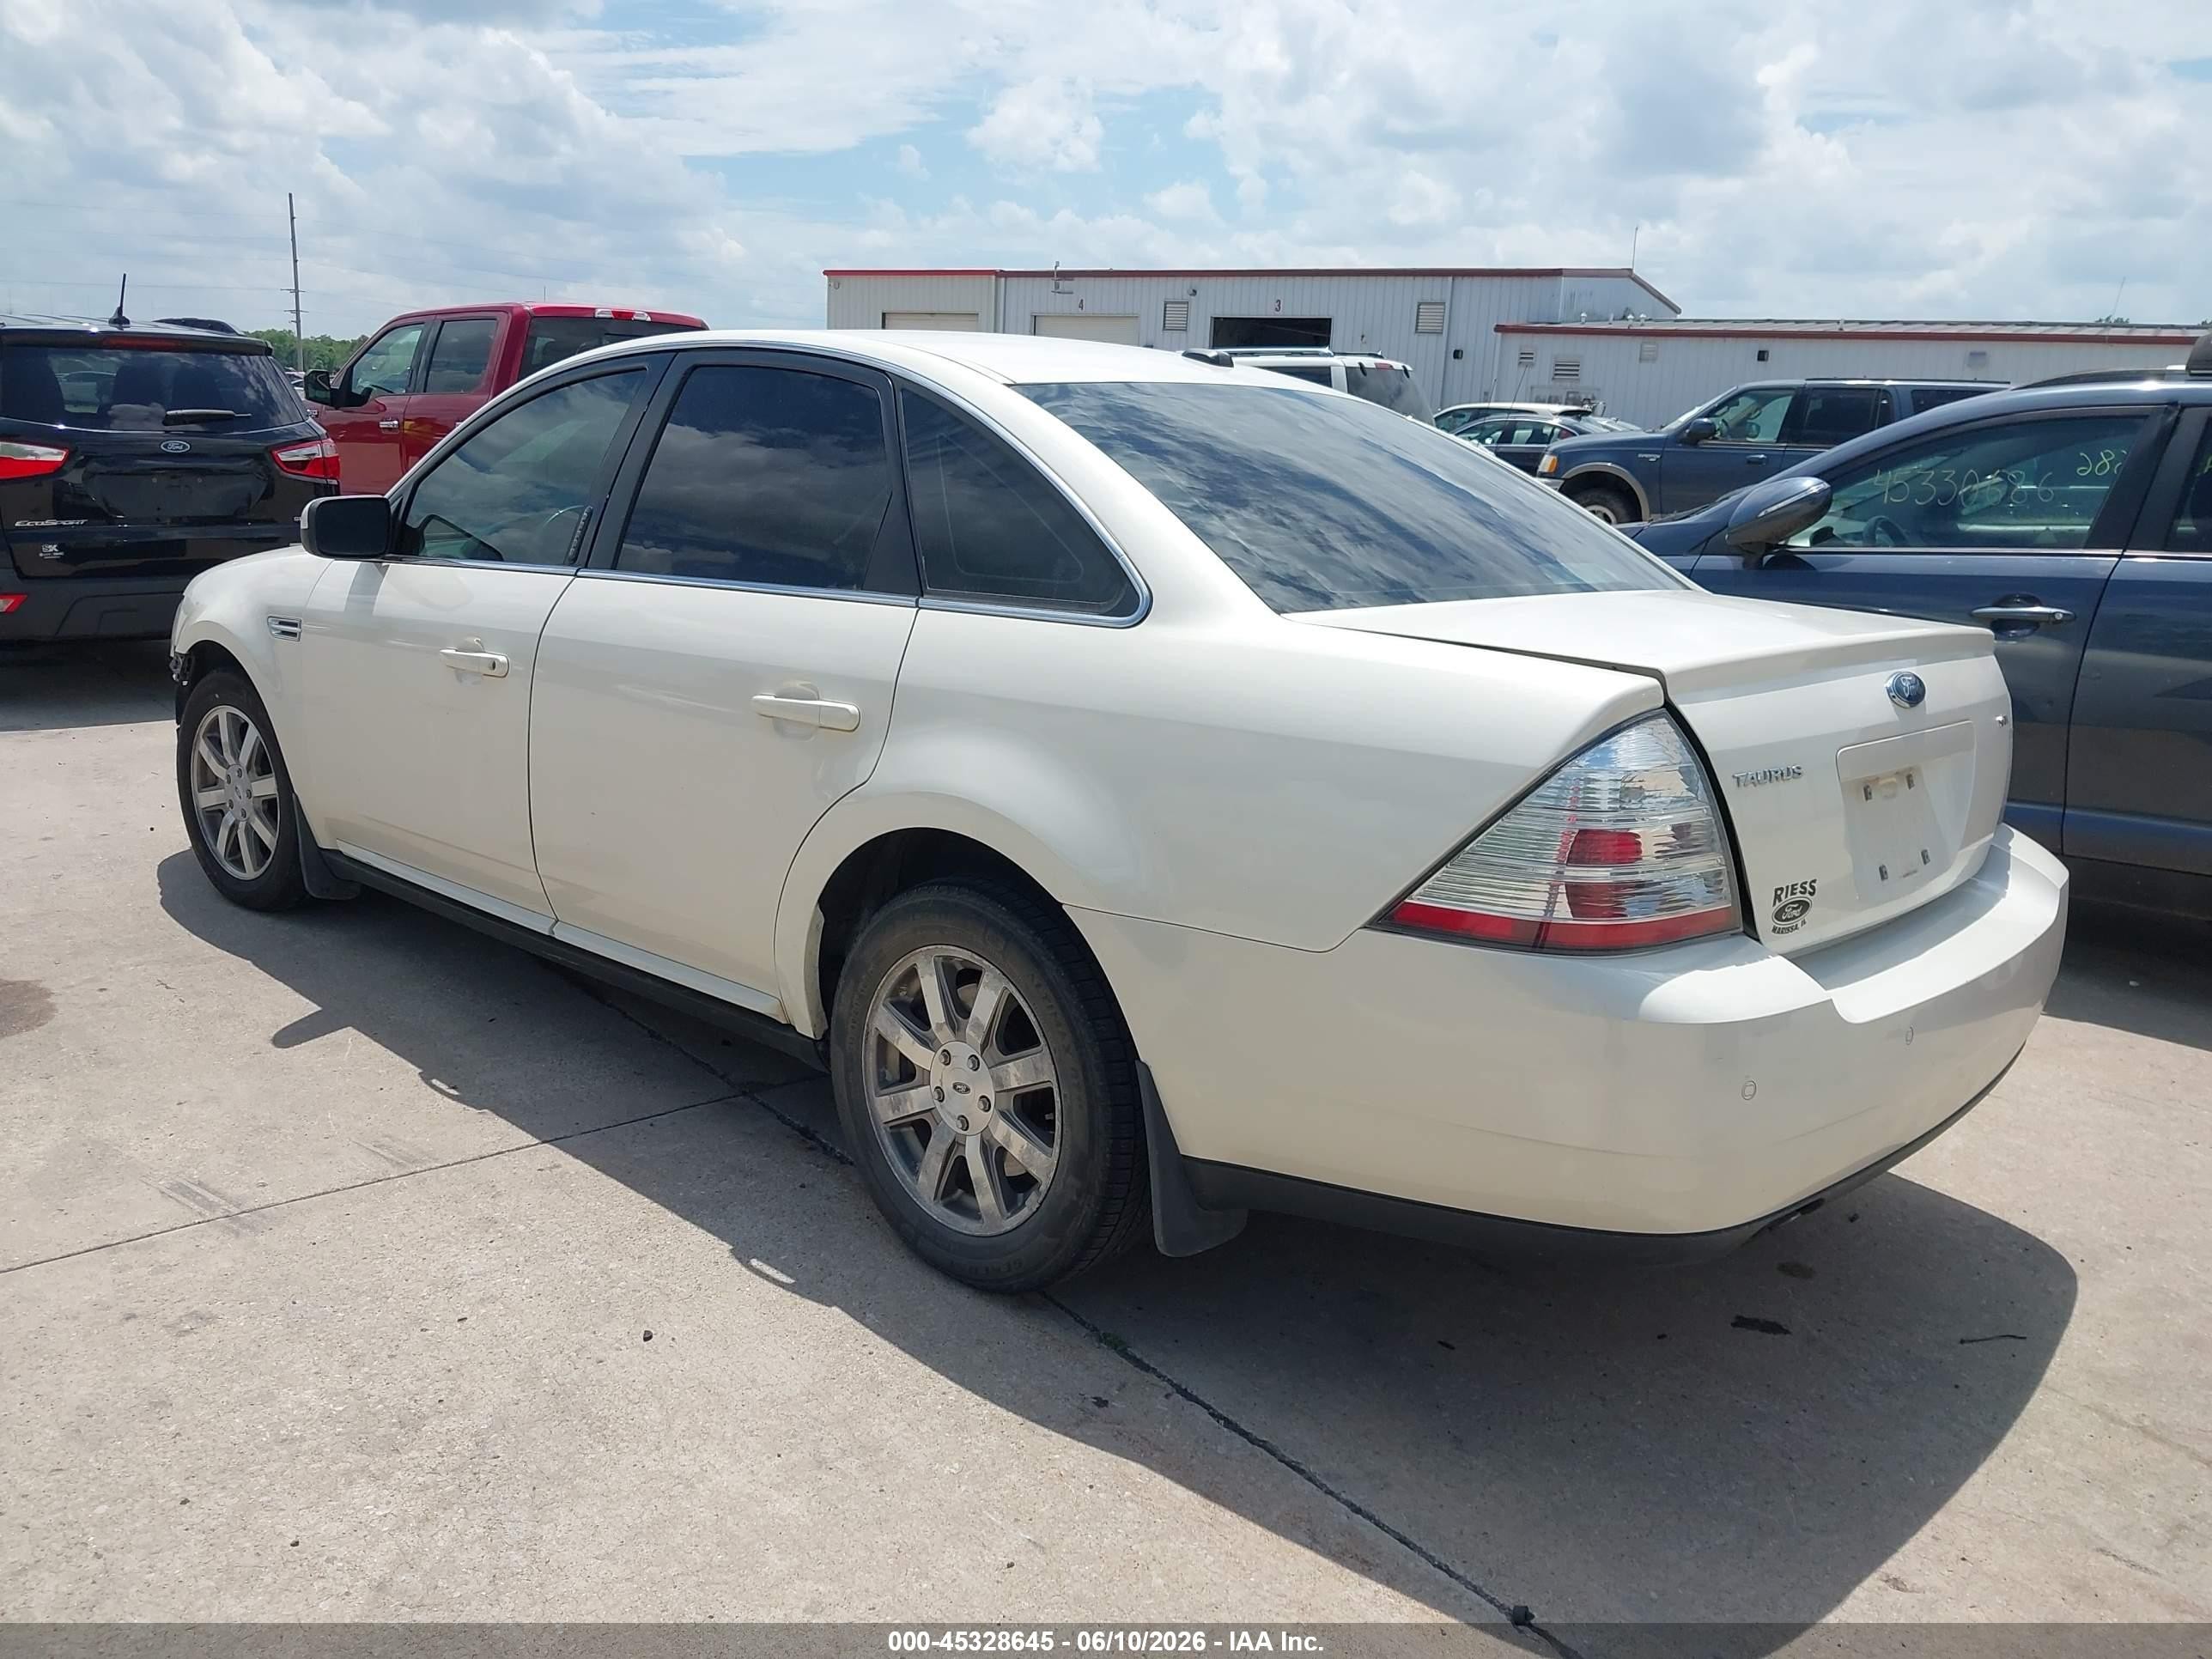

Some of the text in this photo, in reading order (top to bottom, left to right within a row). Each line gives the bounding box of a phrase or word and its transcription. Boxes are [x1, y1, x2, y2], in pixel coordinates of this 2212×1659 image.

[1275, 299, 1281, 313] 3
[1732, 765, 1803, 787] TAURUS
[1772, 878, 1817, 908] RIESS
[1782, 903, 1803, 920] Ford
